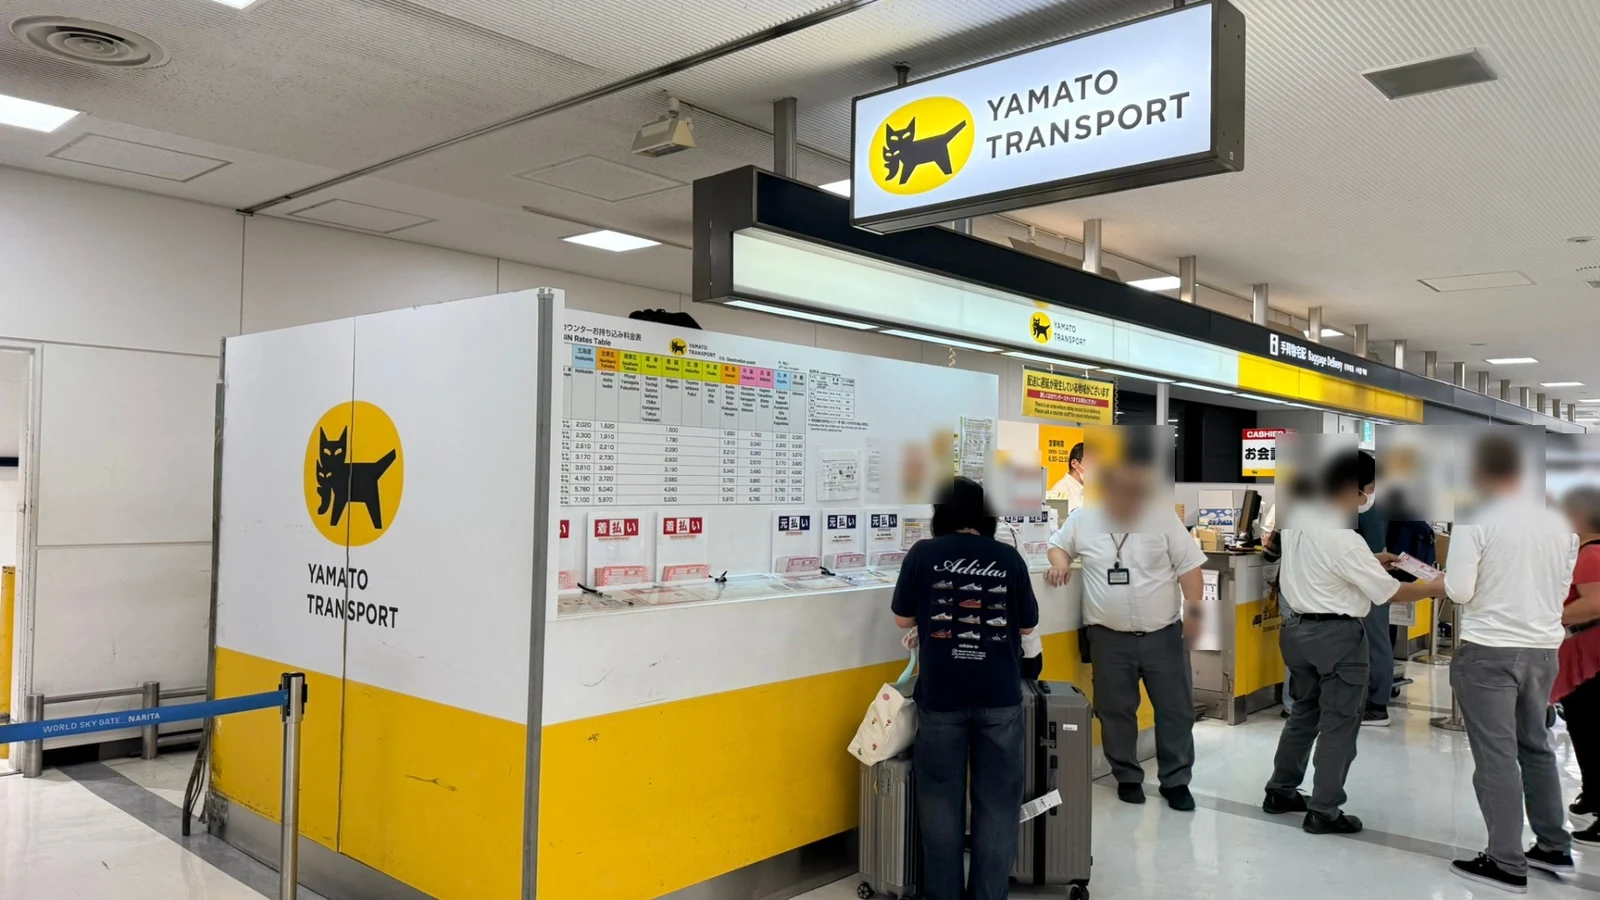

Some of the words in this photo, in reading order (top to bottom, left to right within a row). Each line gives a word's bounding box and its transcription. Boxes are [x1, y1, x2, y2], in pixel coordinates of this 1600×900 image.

[987, 69, 1118, 121] YAMATO
[986, 92, 1190, 159] TRANSPORT
[1054, 321, 1076, 333] YAMATO
[574, 335, 592, 344] Rates
[594, 338, 611, 346] Table
[1054, 332, 1086, 346] TRANSPORT
[688, 349, 716, 358] TRANSPORT
[1308, 350, 1327, 367] Baggage
[1327, 356, 1344, 372] Delivery
[596, 521, 637, 534] 着払い
[665, 520, 701, 532] 着払い
[779, 517, 809, 530] 元払い
[828, 516, 856, 528] 元払い
[872, 515, 897, 527] 元払い
[933, 558, 1007, 578] Adidas
[308, 563, 368, 590] YAMATO
[307, 594, 398, 628] TRANSPORT
[42, 722, 77, 733] WORLD
[80, 720, 98, 729] SKY
[128, 712, 160, 722] NARITA
